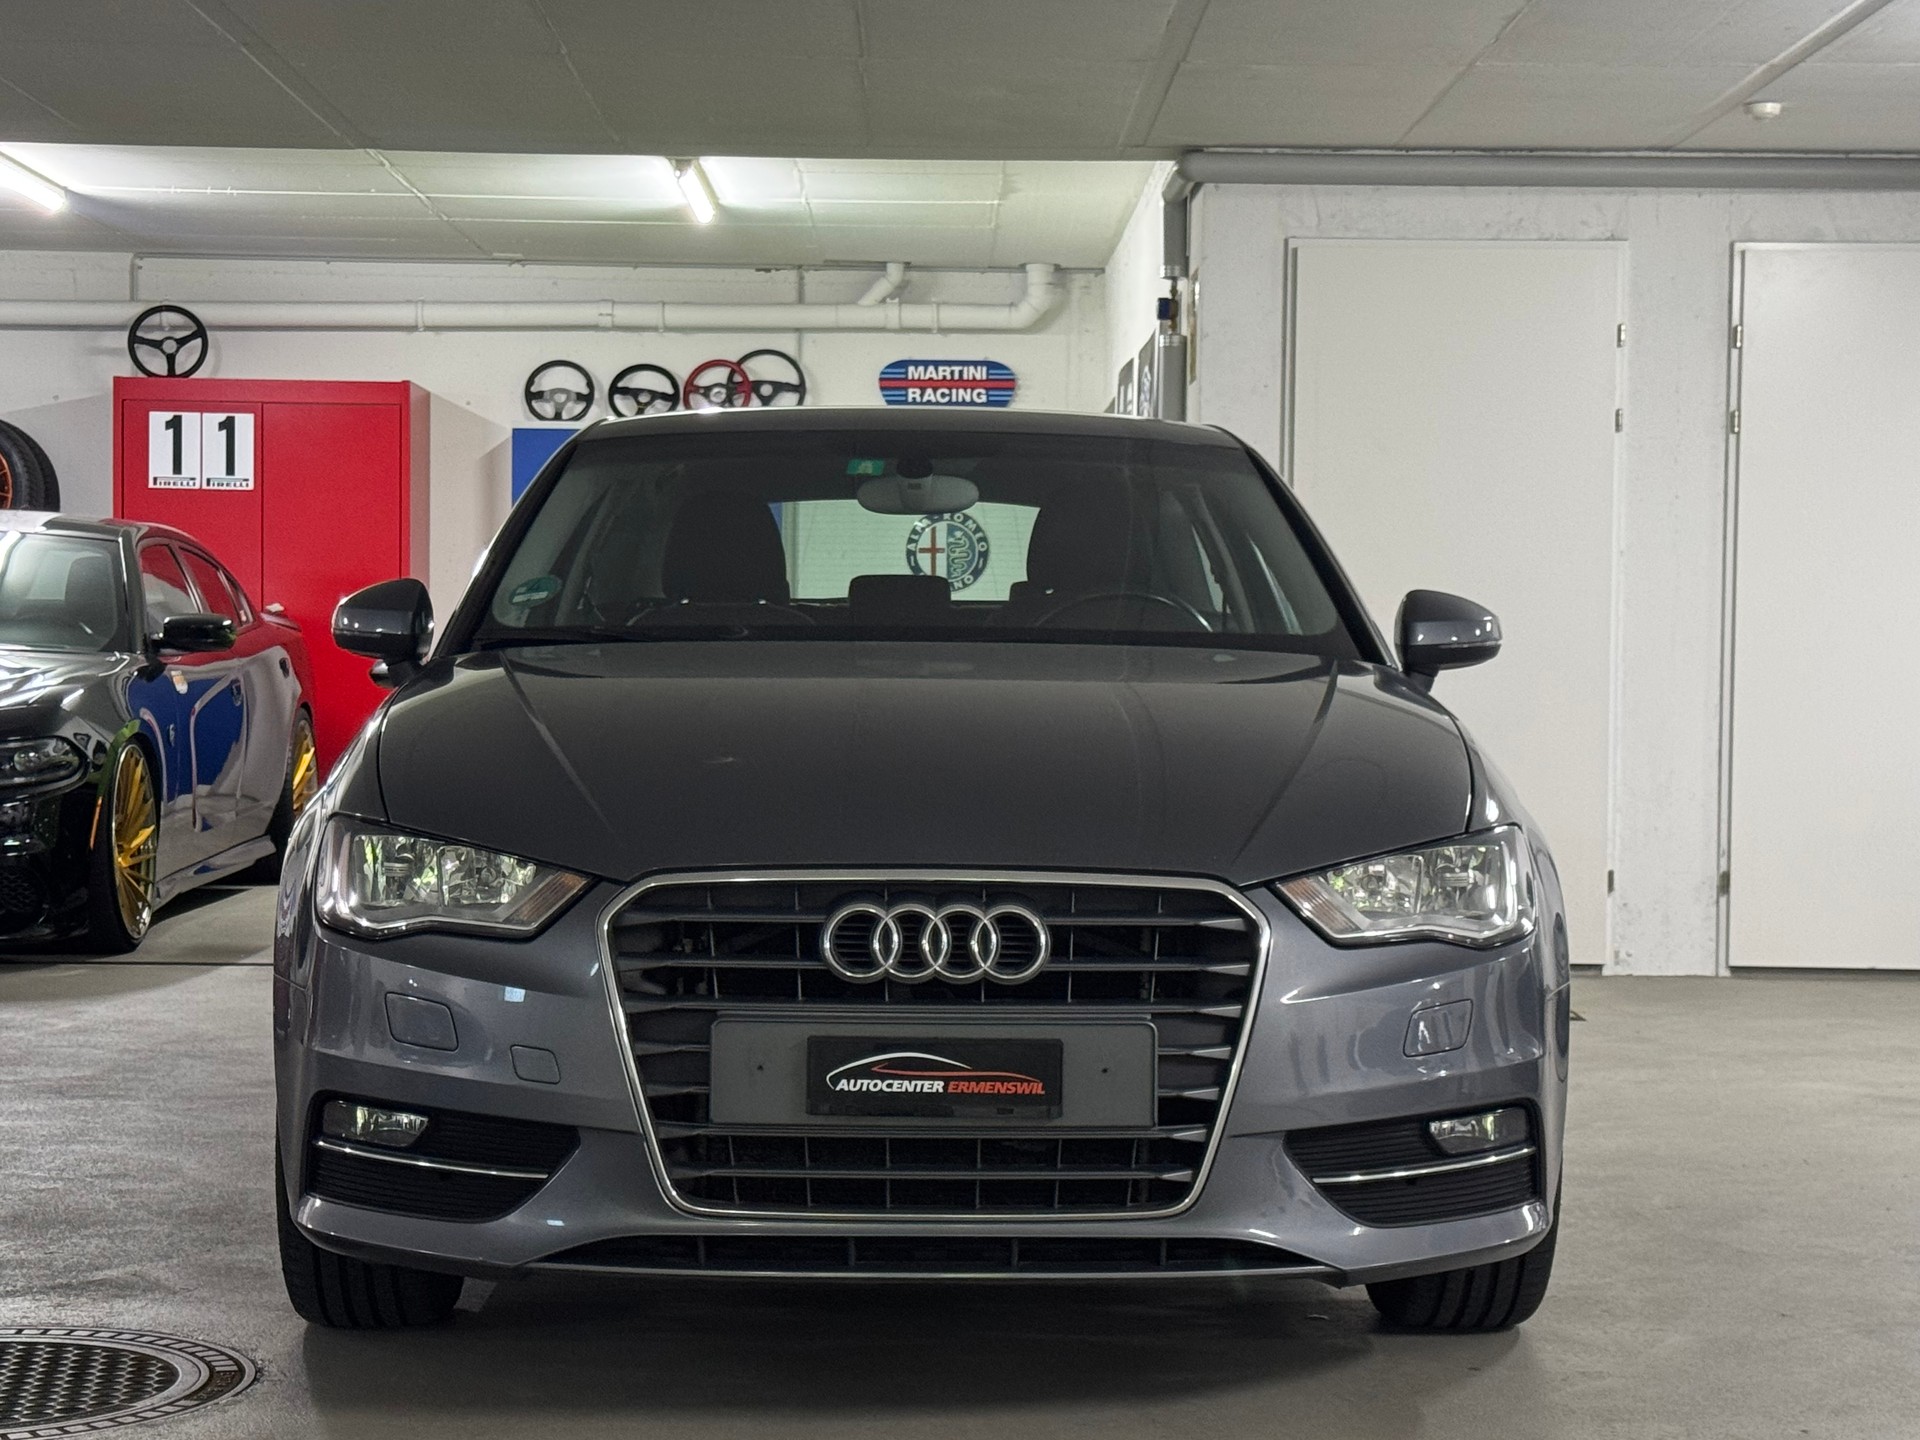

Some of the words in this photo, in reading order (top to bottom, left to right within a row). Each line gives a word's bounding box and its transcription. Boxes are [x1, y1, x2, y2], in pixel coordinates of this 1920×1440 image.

[907, 365, 987, 380] MARTINI
[907, 387, 987, 403] RACING
[153, 477, 196, 487] PIRELLI
[206, 478, 249, 488] PIRELLI
[835, 1079, 944, 1093] AUTOCENTER
[947, 1080, 1045, 1095] ERMENSWIL
